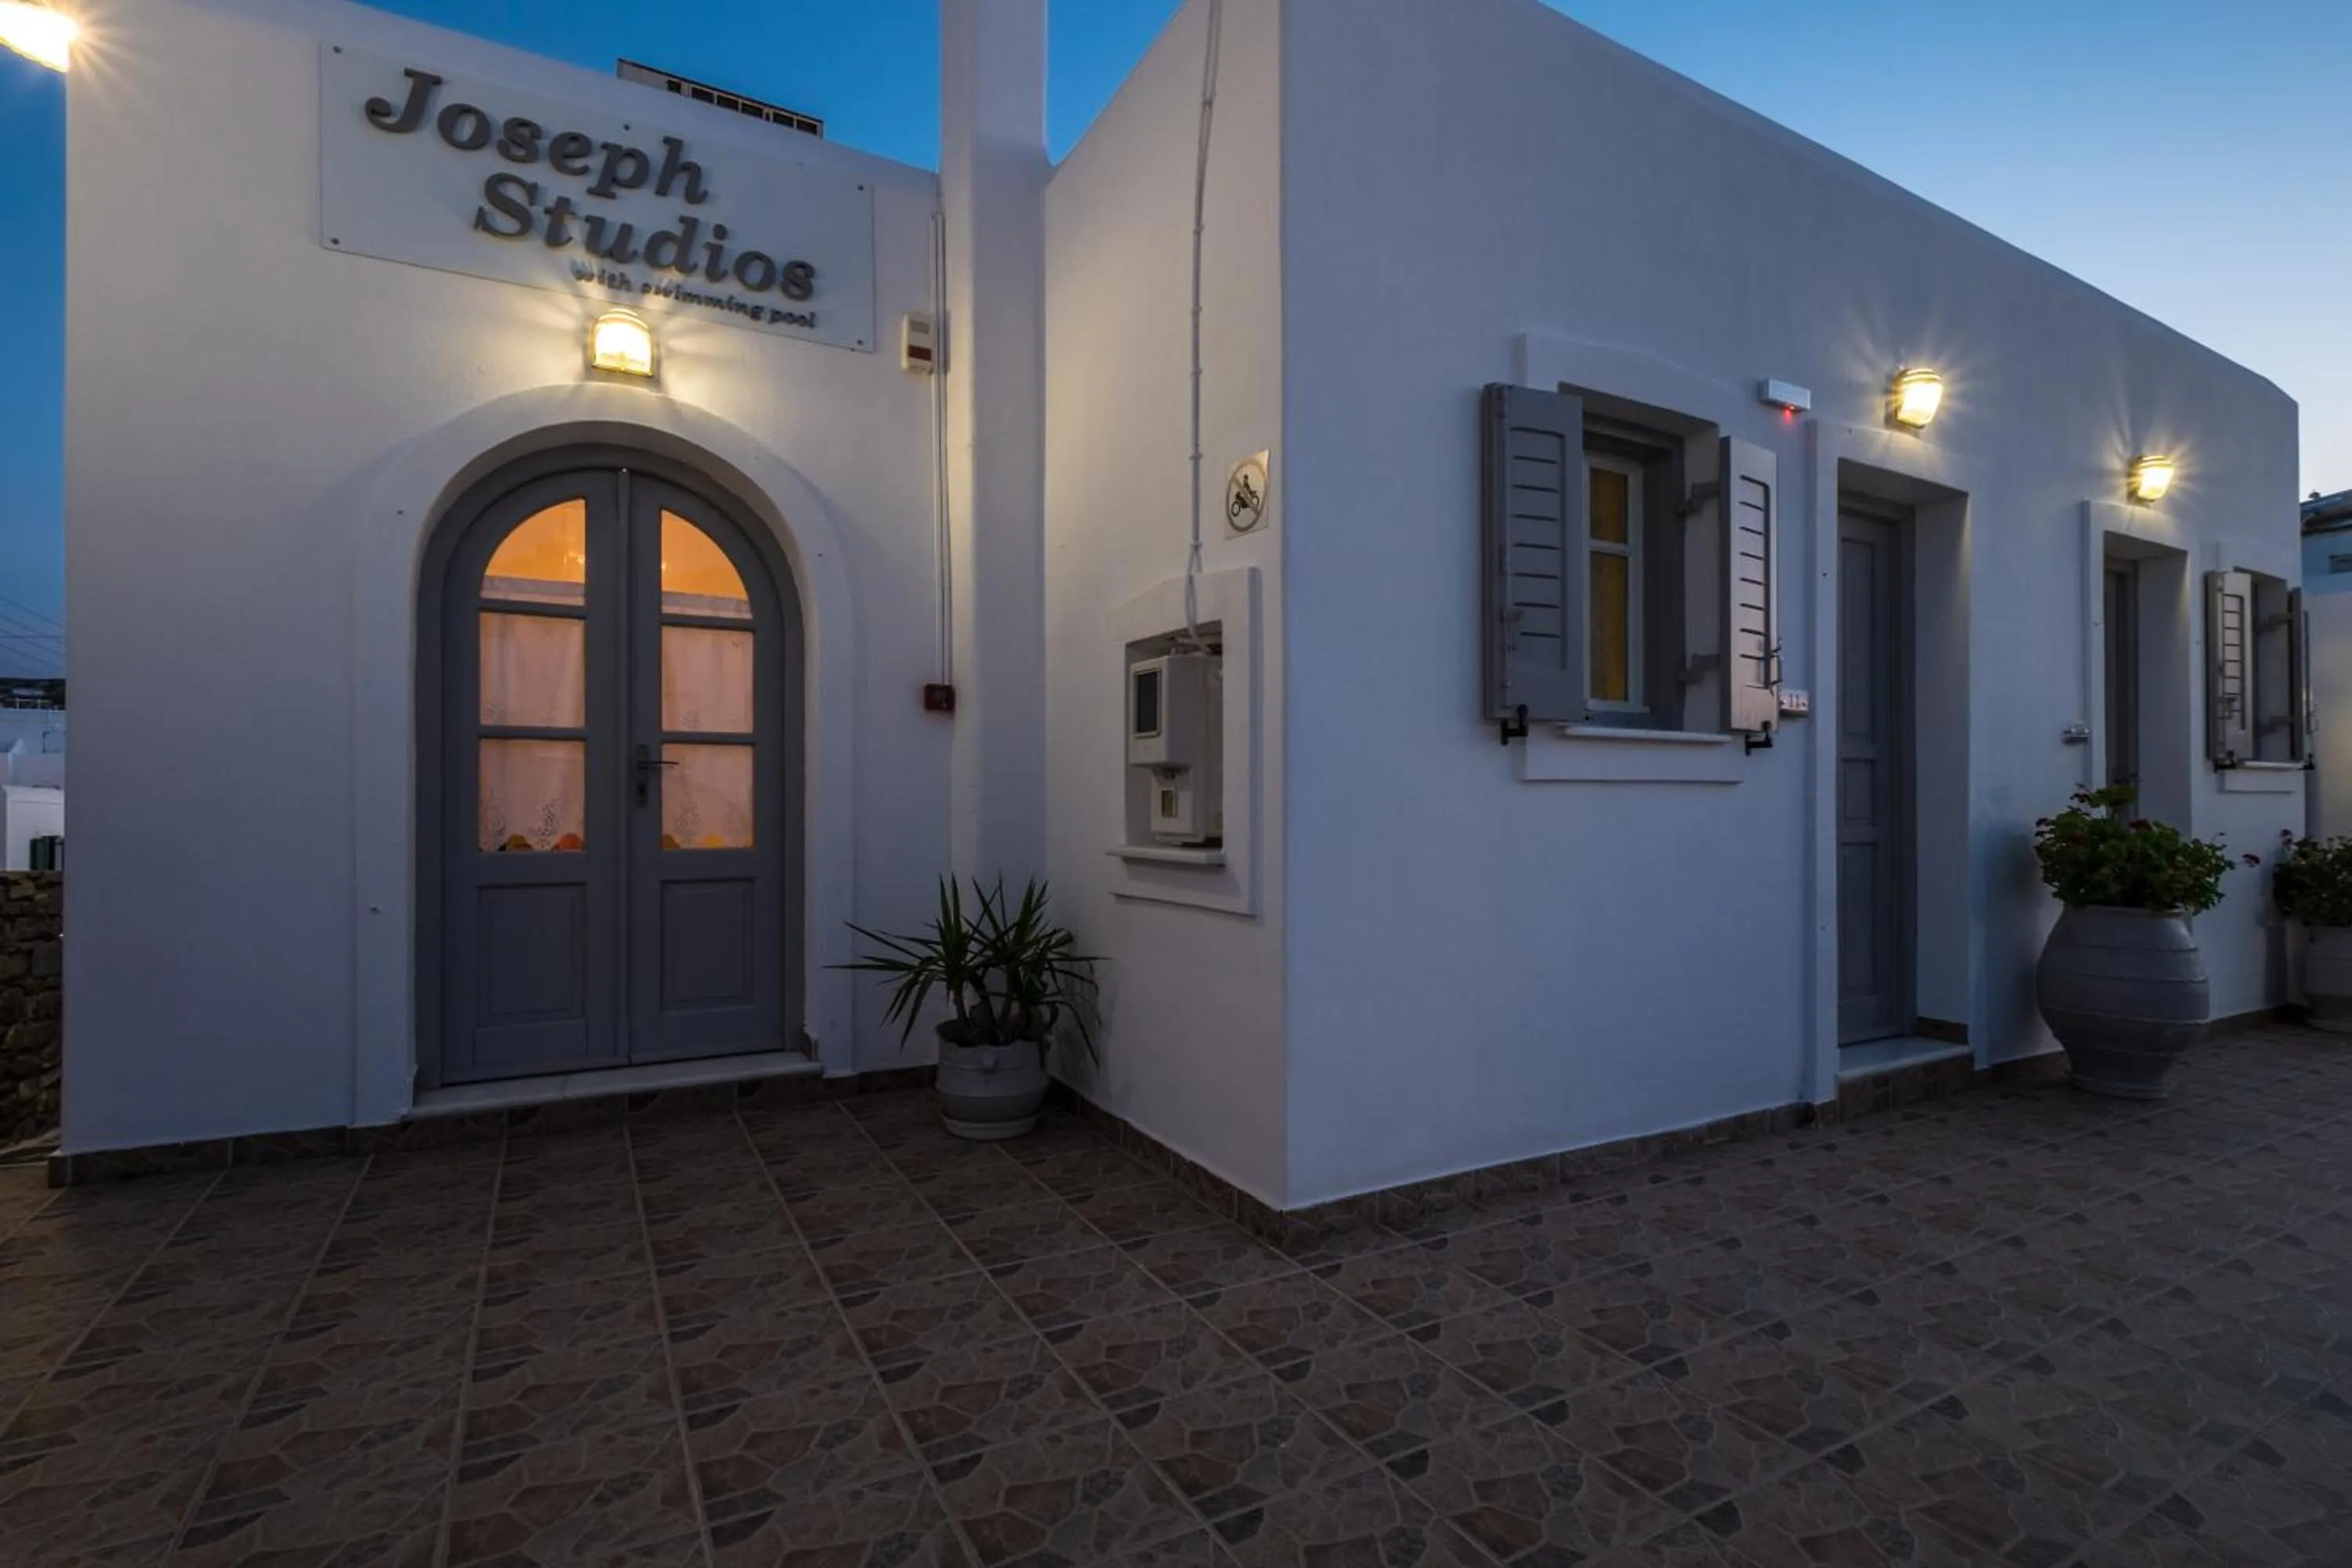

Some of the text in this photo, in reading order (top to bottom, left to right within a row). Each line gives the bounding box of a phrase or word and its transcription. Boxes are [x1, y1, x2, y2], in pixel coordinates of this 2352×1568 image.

[364, 67, 709, 205] Joseph
[473, 172, 816, 301] Studios
[572, 262, 816, 328] with swimming pool
